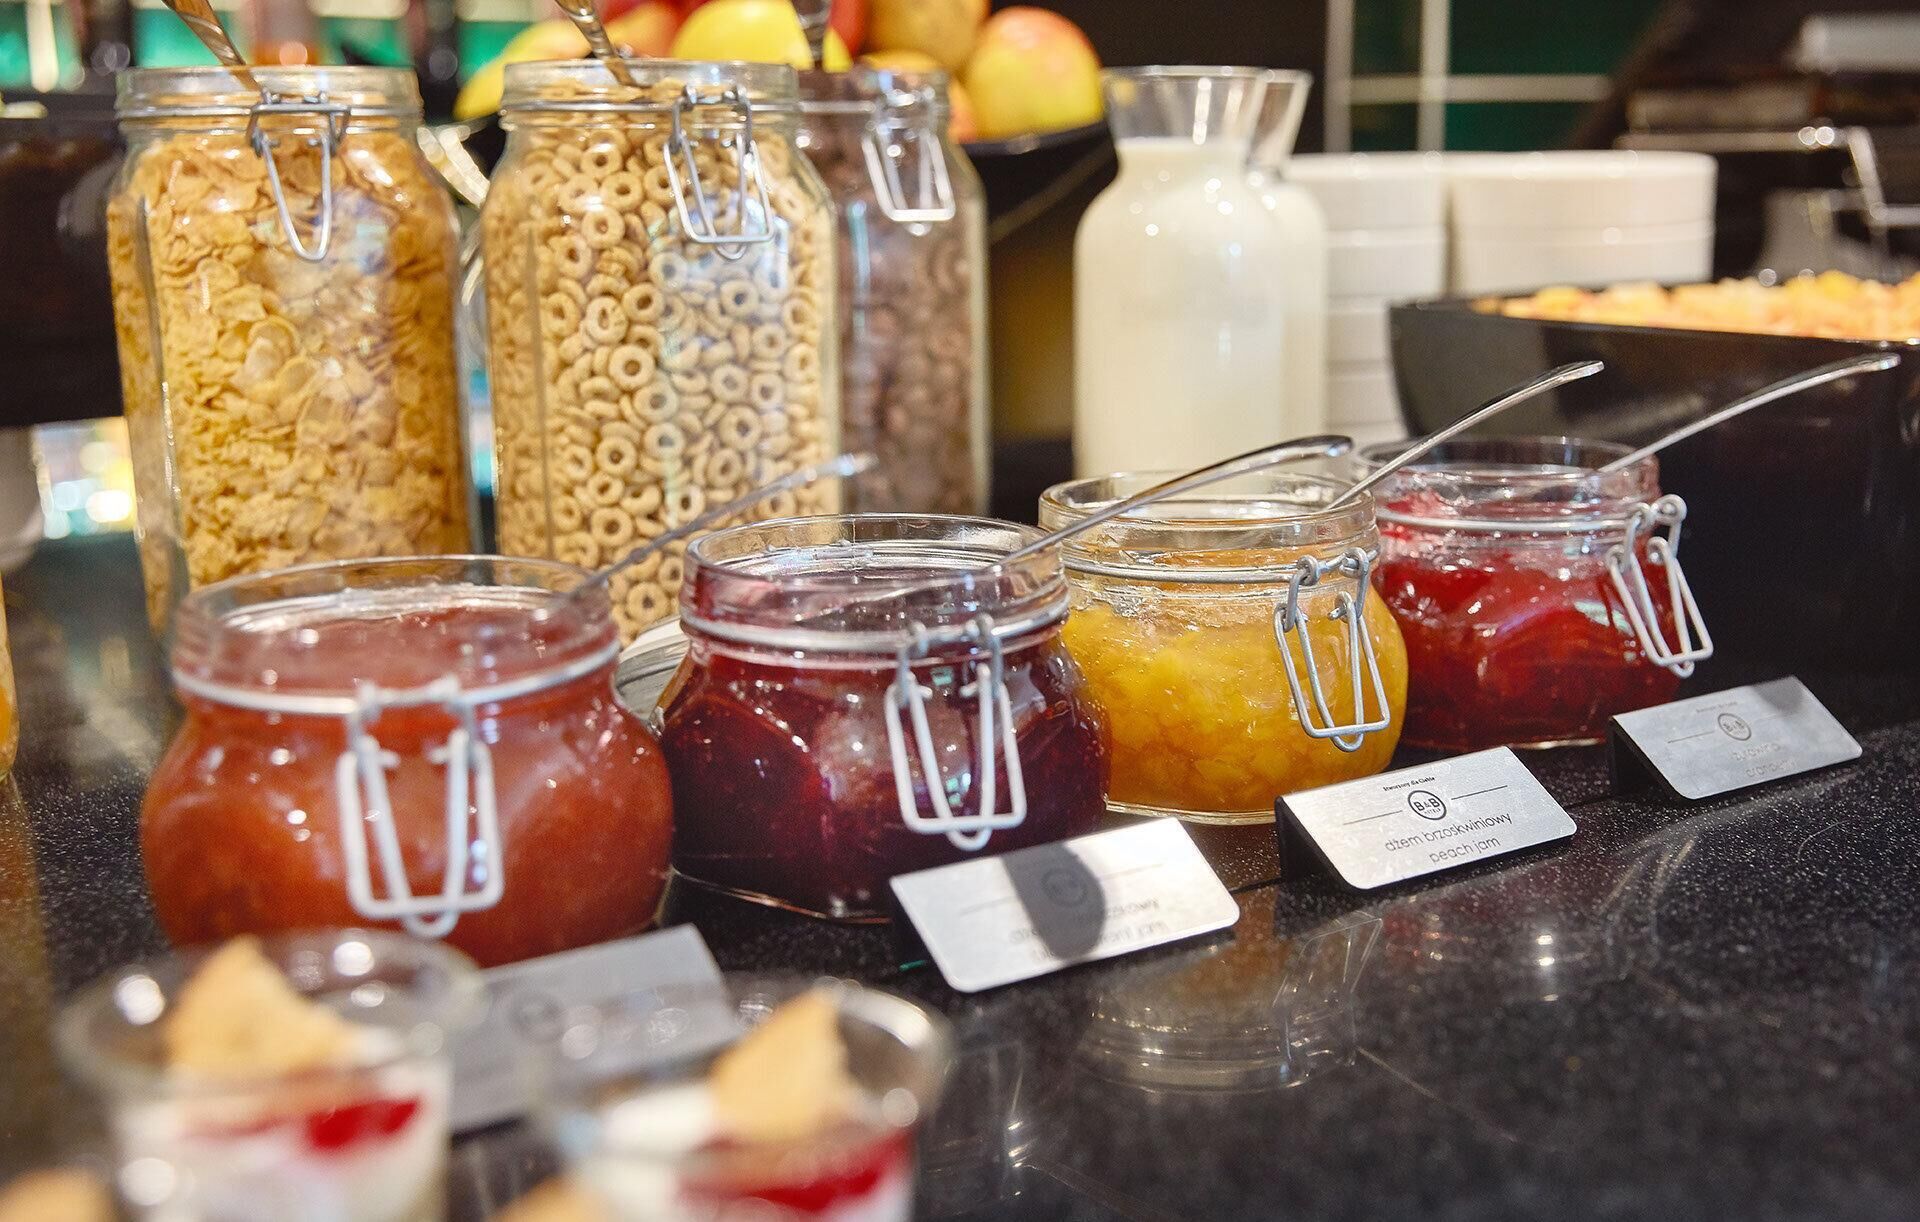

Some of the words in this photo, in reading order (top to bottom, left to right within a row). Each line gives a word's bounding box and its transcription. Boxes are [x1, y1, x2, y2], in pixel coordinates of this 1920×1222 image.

[1413, 798, 1440, 811] B&B
[1384, 834, 1424, 852] dżem
[1422, 813, 1513, 842] brzoskwiniowy
[1429, 843, 1474, 863] peach
[1473, 836, 1502, 854] jam
